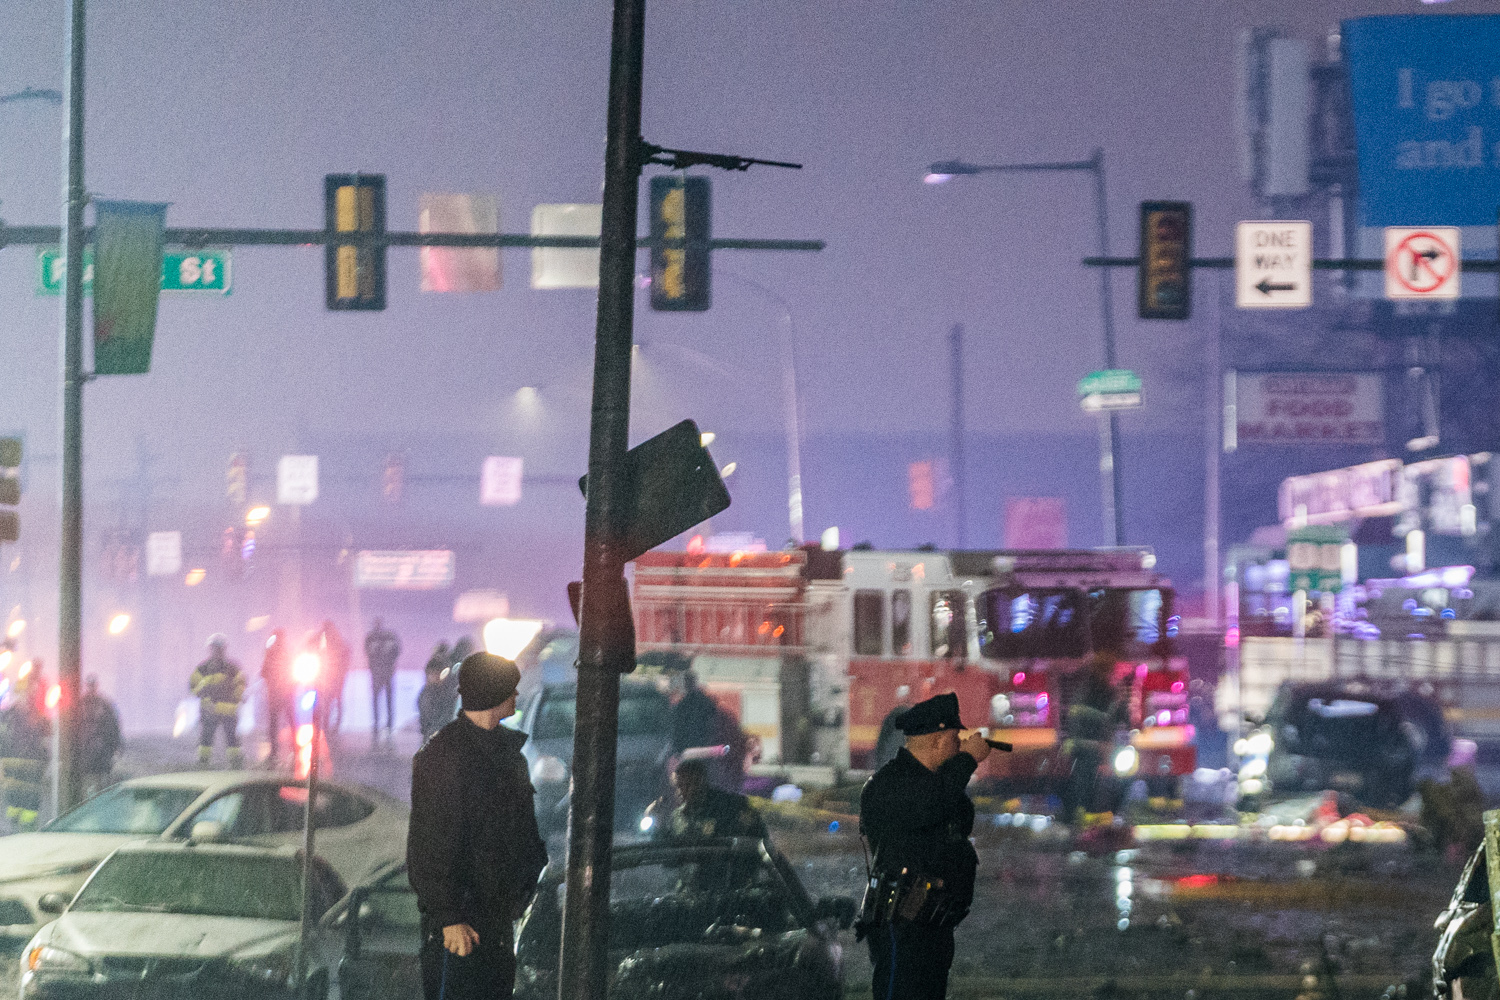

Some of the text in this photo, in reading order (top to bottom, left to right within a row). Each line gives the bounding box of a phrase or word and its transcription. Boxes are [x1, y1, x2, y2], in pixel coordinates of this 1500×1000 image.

[1397, 67, 1415, 108] I
[1427, 80, 1483, 121] go
[1397, 125, 1483, 168] and
[1255, 229, 1296, 249] ONE
[180, 257, 216, 284] St
[1254, 254, 1297, 271] WAY
